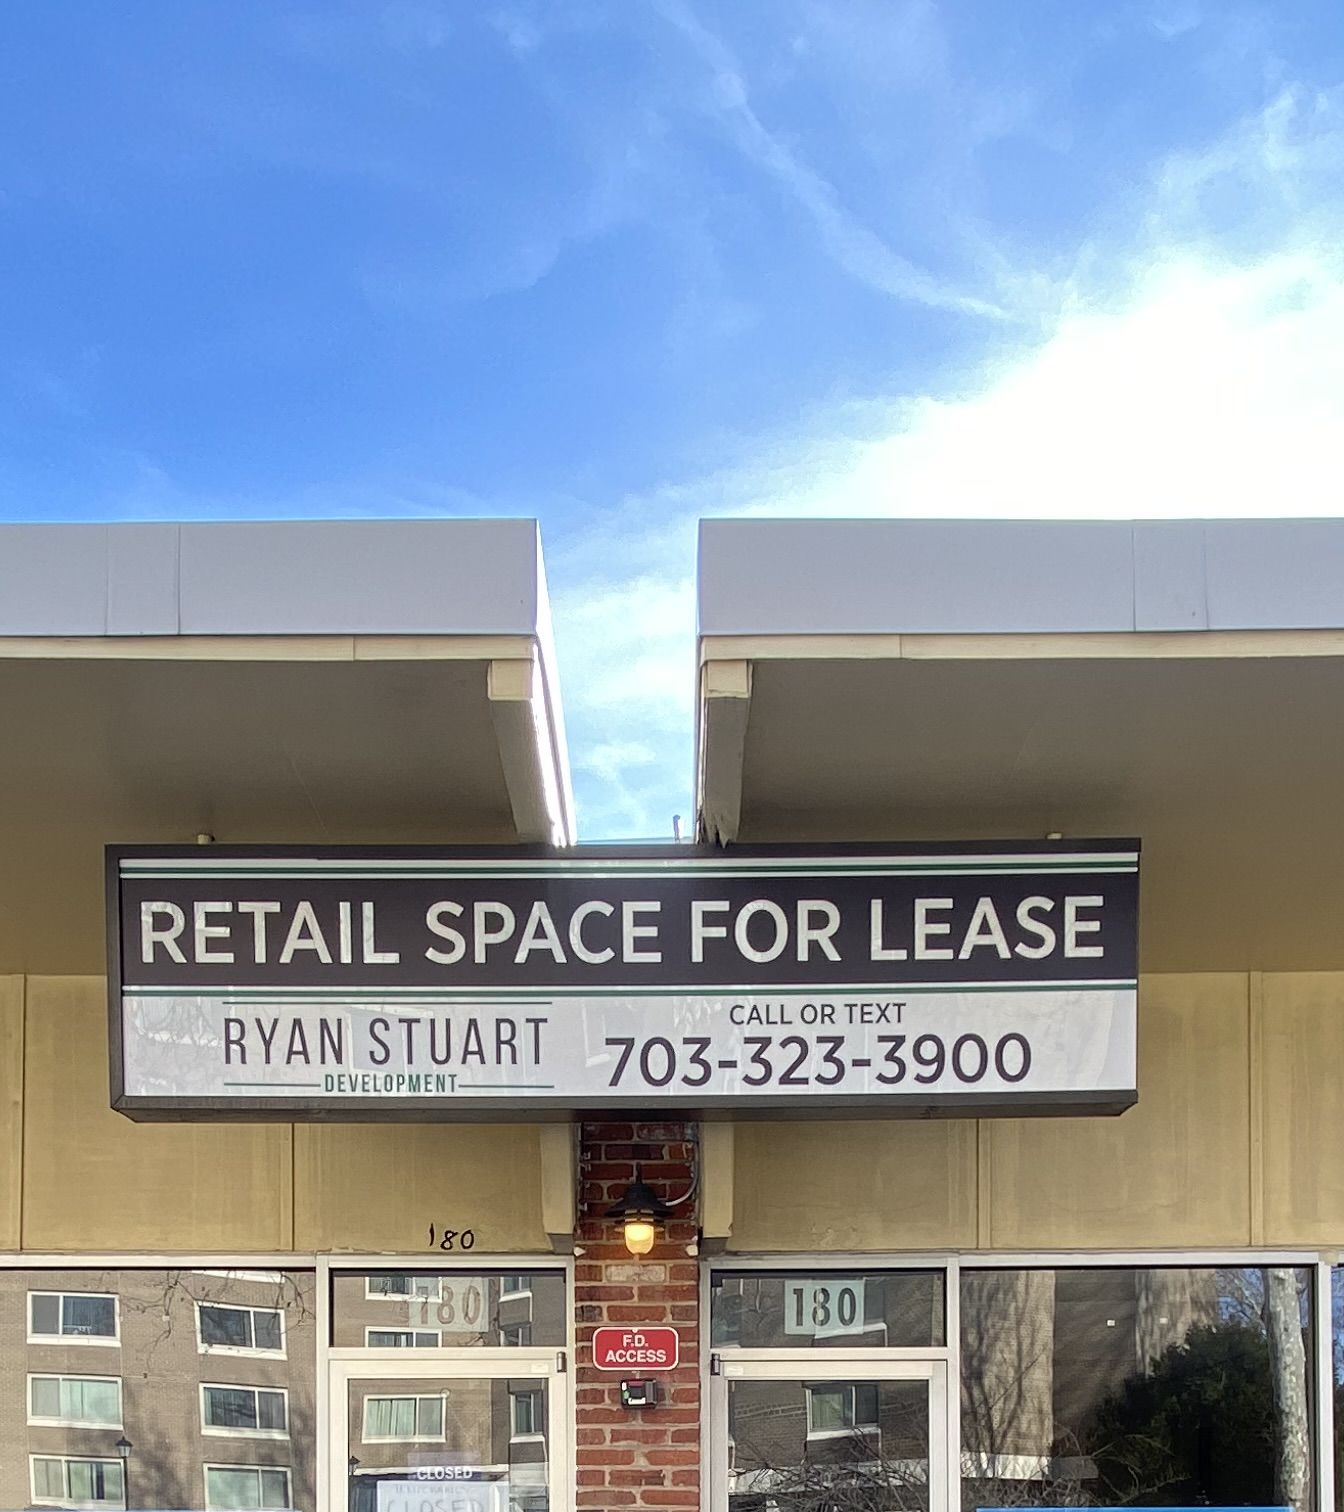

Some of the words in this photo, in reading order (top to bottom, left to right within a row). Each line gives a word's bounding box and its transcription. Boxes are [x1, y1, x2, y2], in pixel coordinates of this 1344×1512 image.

[140, 900, 401, 966] RETAIL
[424, 899, 663, 965] SPACE
[691, 898, 842, 963] FOR
[870, 894, 1105, 962] LEASE
[729, 1004, 795, 1026] CALL
[800, 1003, 837, 1025] OR
[843, 1002, 907, 1025] TEXT
[222, 1017, 345, 1067] RYAN
[368, 1015, 549, 1067] STUART
[604, 1031, 1033, 1088] 703-323-3900
[323, 1073, 459, 1094] DEVELOPMENT
[428, 1222, 475, 1250] 180
[792, 1286, 857, 1328] 180
[622, 1334, 649, 1348] F.D.
[605, 1349, 667, 1363] ACCESS
[416, 1466, 474, 1480] CLOSED
